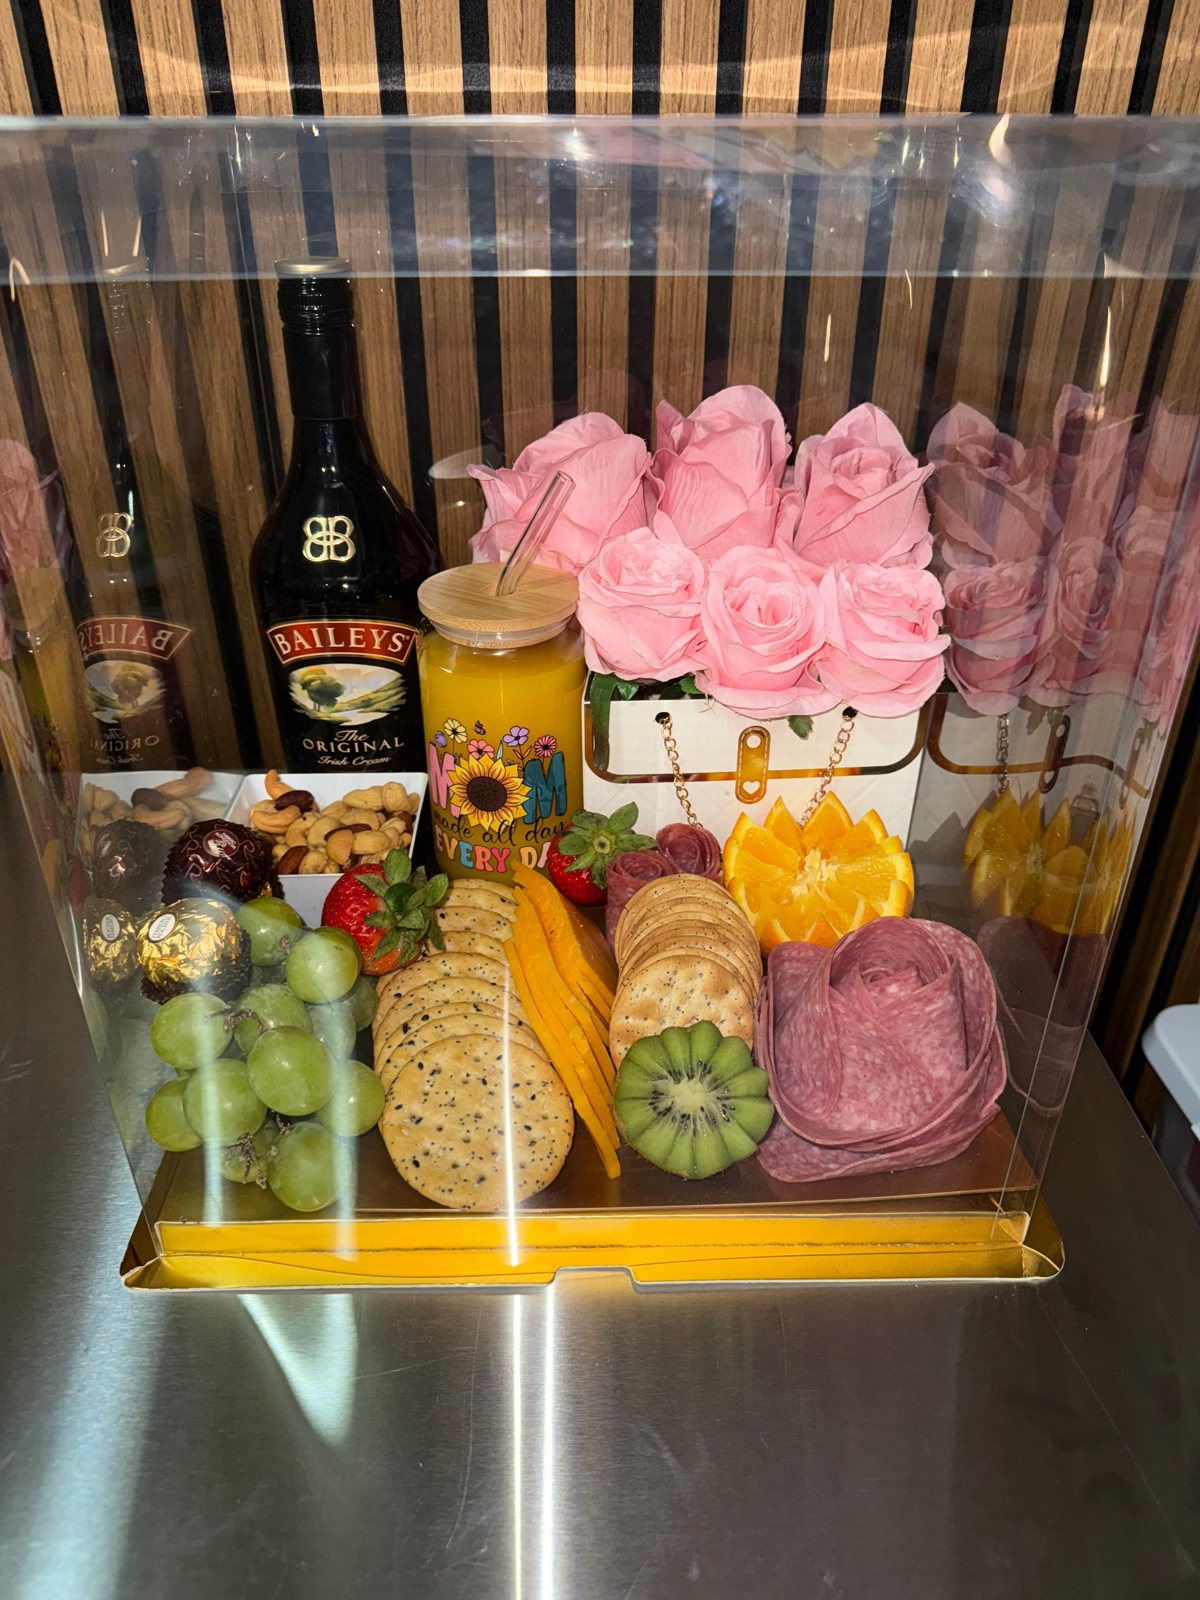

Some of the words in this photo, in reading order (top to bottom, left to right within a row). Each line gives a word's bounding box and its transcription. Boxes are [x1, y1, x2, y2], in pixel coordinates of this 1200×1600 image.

[274, 627, 407, 655] BAILEYS
[302, 736, 404, 753] ORIGINAL
[334, 729, 370, 742] The
[317, 755, 350, 766] Irish
[352, 755, 392, 766] Cream
[482, 819, 517, 847] all
[435, 824, 511, 874] EVERY
